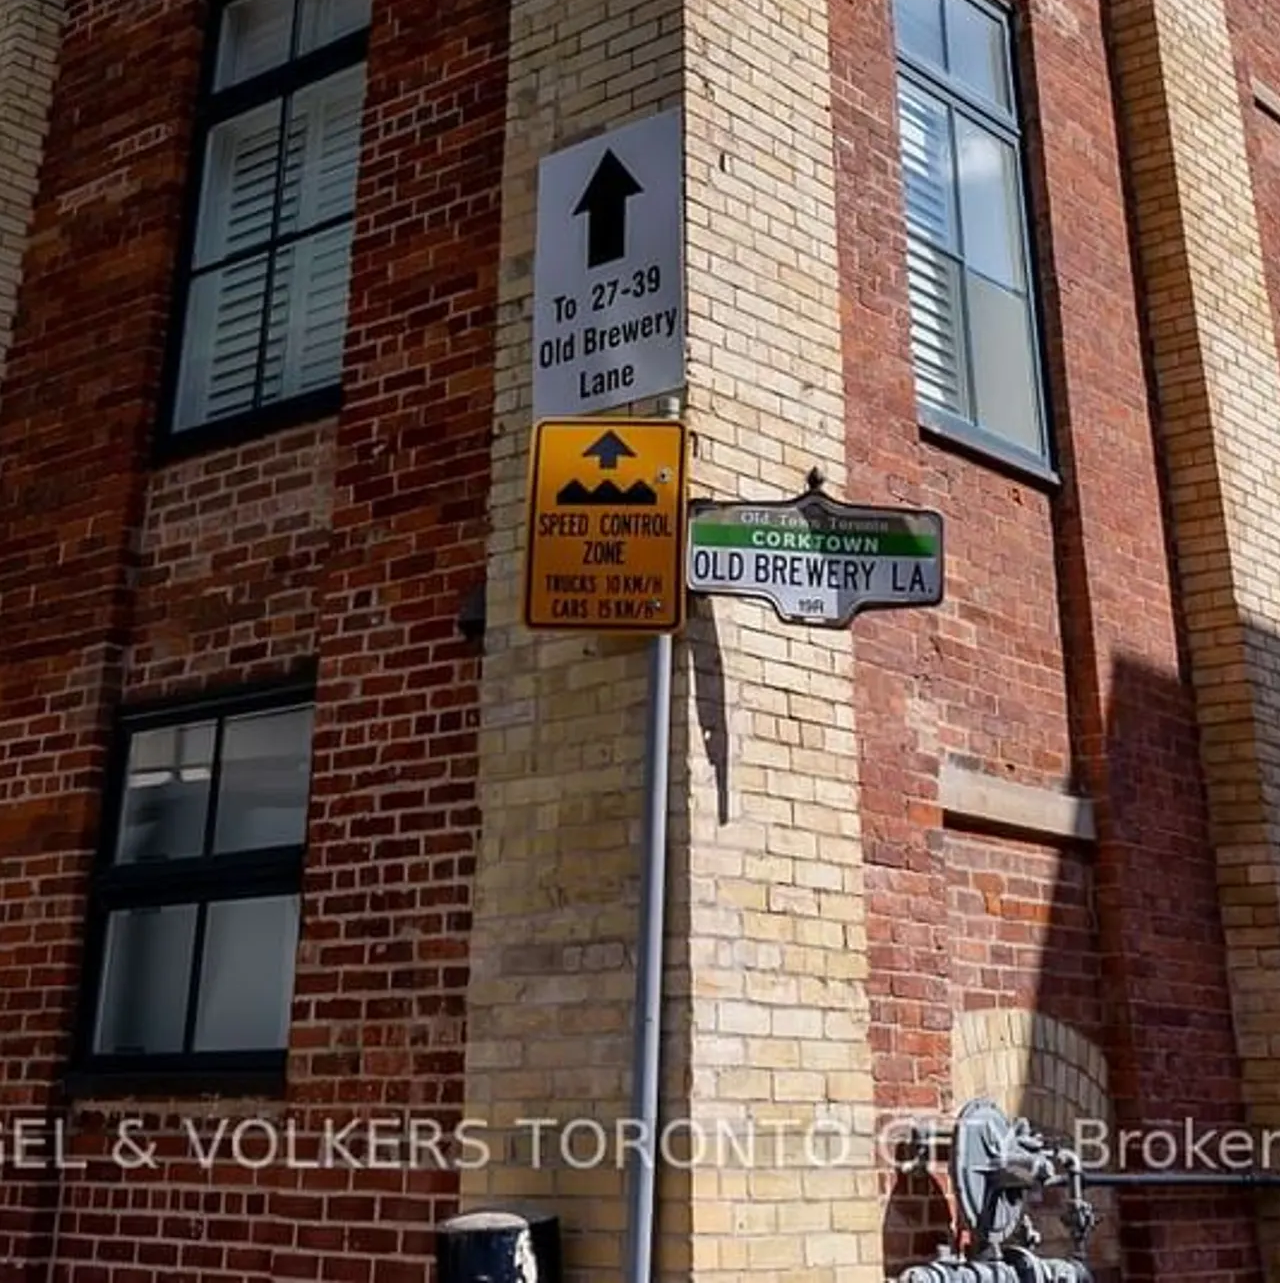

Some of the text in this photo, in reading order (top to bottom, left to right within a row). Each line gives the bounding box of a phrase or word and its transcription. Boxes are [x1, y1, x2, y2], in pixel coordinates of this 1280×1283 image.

[553, 265, 662, 324] To 27-39
[539, 307, 678, 369] Old Brewery
[579, 365, 635, 399] Lane
[538, 512, 672, 537] SPEED CONTROL
[740, 511, 769, 525] Old
[582, 540, 628, 565] ZONE
[751, 530, 880, 553] CORKTOWN
[546, 573, 597, 594] TRUCKS
[693, 550, 933, 595] OLD BREWERY LA.
[551, 598, 589, 619] CARS
